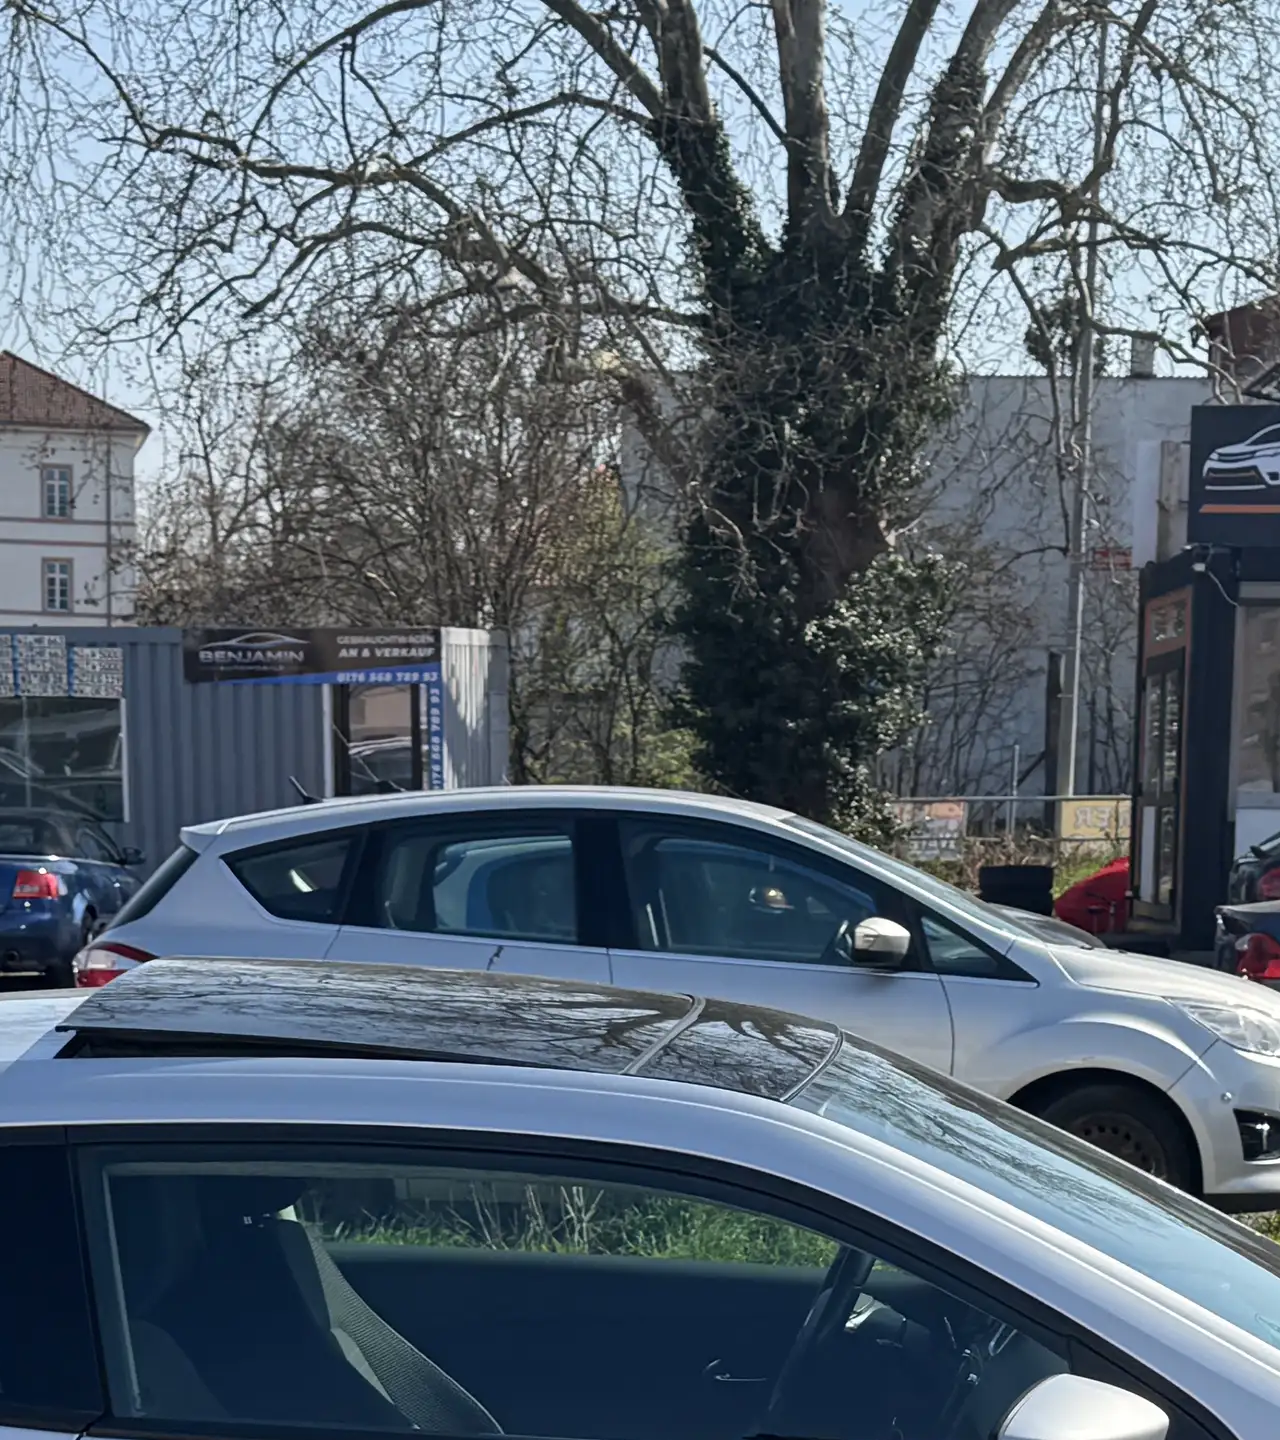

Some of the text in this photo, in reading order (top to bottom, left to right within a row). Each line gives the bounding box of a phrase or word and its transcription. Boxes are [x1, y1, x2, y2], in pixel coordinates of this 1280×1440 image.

[198, 649, 305, 663] BENJAMIN
[338, 648, 359, 658] AN
[375, 647, 436, 658] VERKAUF
